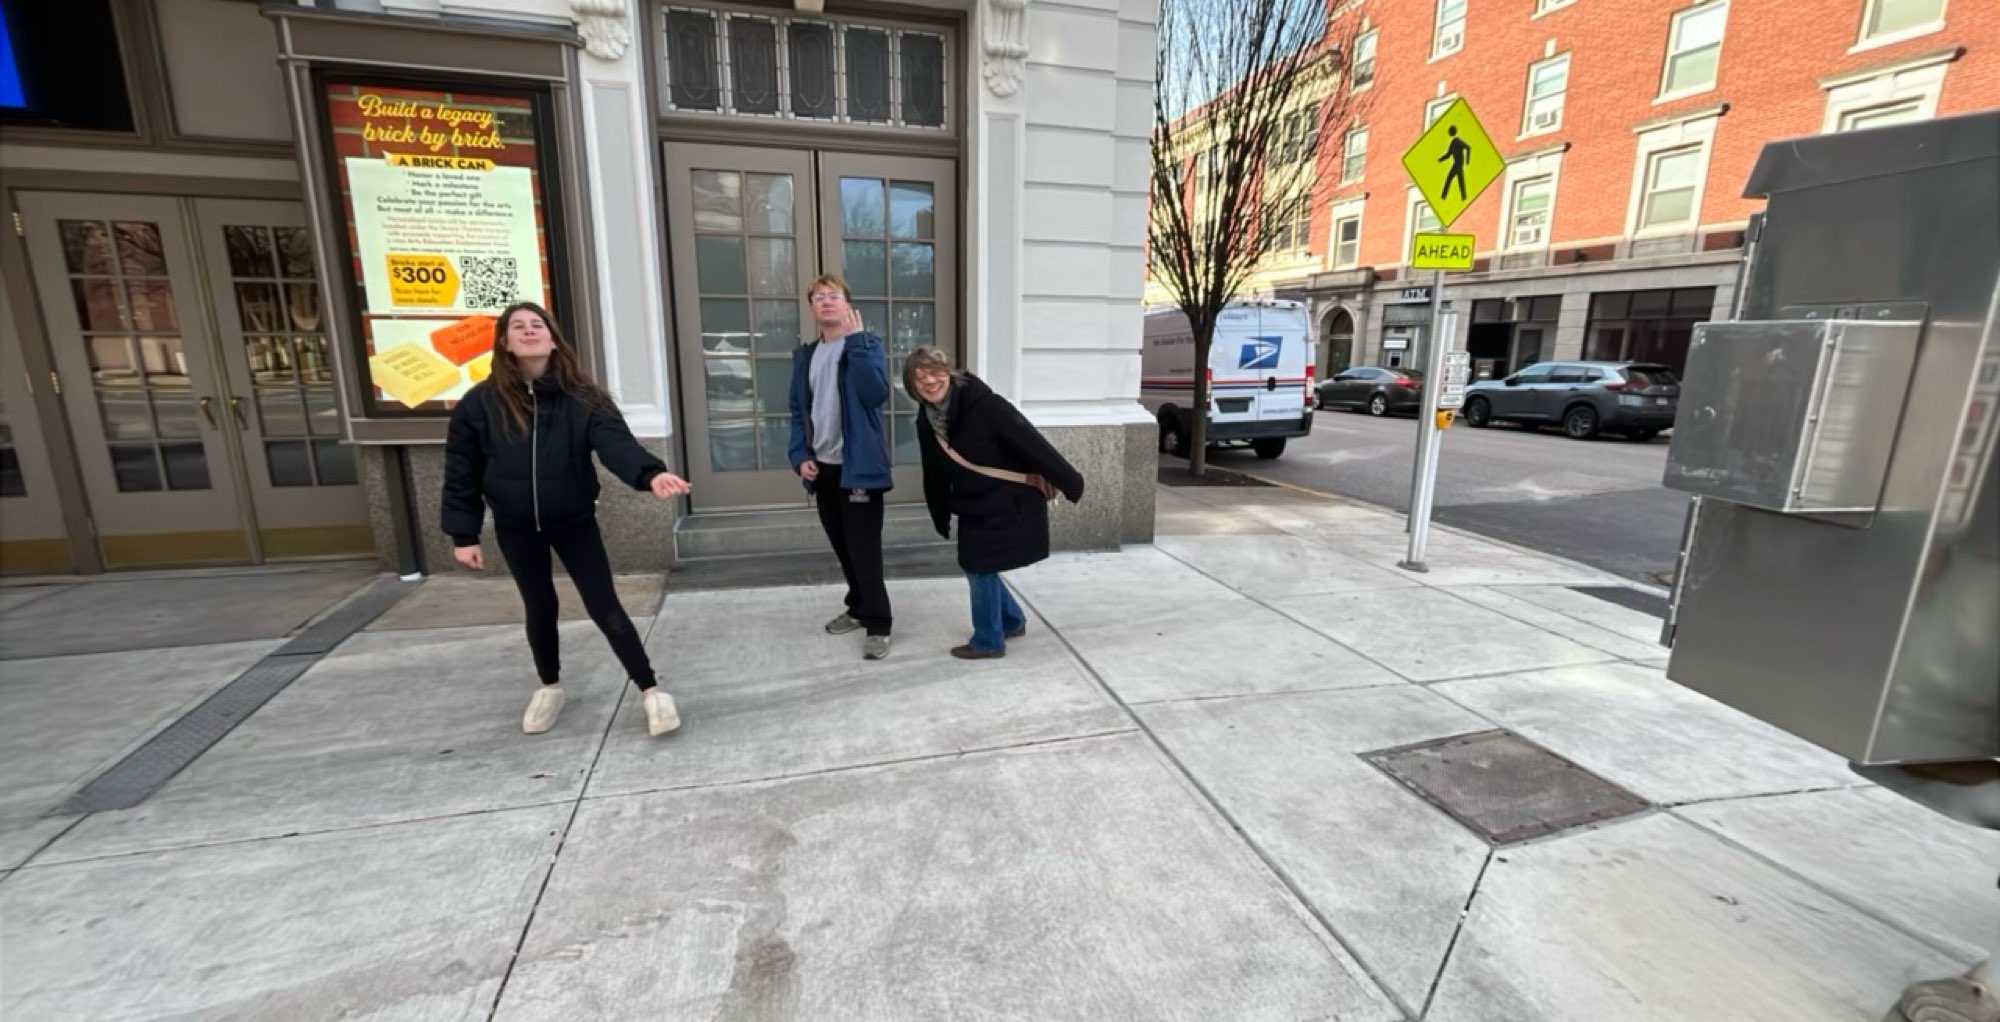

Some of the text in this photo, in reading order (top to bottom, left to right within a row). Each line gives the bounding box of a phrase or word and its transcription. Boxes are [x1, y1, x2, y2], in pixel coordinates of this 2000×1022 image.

[358, 94, 417, 117] Build
[420, 108, 434, 118] a
[363, 122, 505, 151] brick by brick.
[400, 157, 486, 170] A BRICK CAN
[1417, 244, 1471, 258] AHEAD
[393, 267, 446, 284] $300
[1402, 289, 1426, 299] ATM
